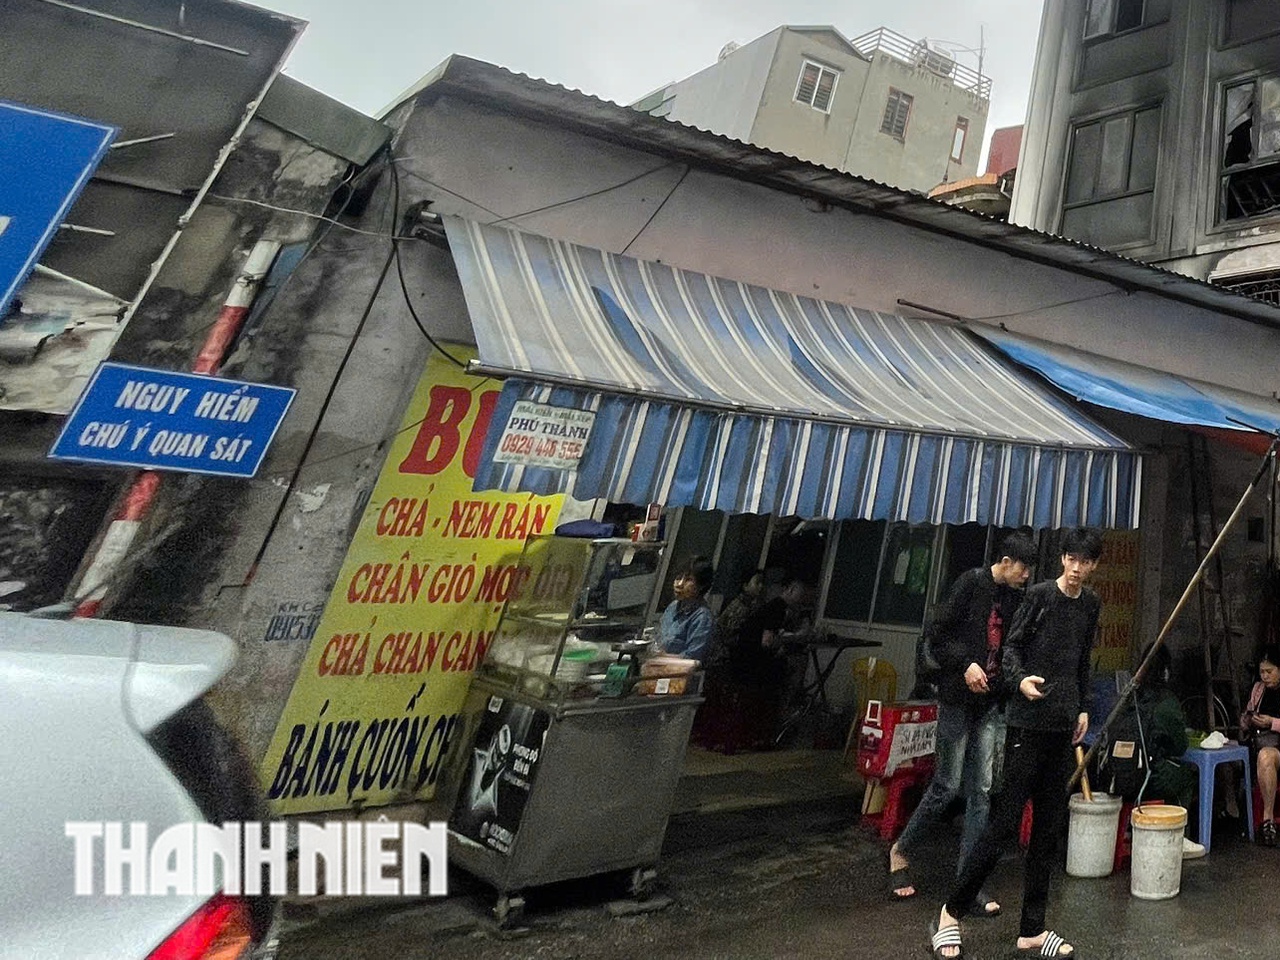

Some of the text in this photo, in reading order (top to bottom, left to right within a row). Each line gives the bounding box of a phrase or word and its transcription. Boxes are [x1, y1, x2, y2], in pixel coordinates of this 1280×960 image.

[115, 380, 260, 423] NGUY HIỂM
[79, 419, 252, 463] CHÚ Ý QUAN SÁT
[501, 433, 534, 455] 0929
[508, 417, 589, 439] PHÚ THÀNH
[441, 499, 501, 539] NEM
[495, 493, 552, 539] RÁN
[347, 551, 430, 604] CHÂN
[373, 630, 445, 675] CHAN
[268, 699, 360, 800] BÁNH
[346, 682, 431, 796] CUỐN
